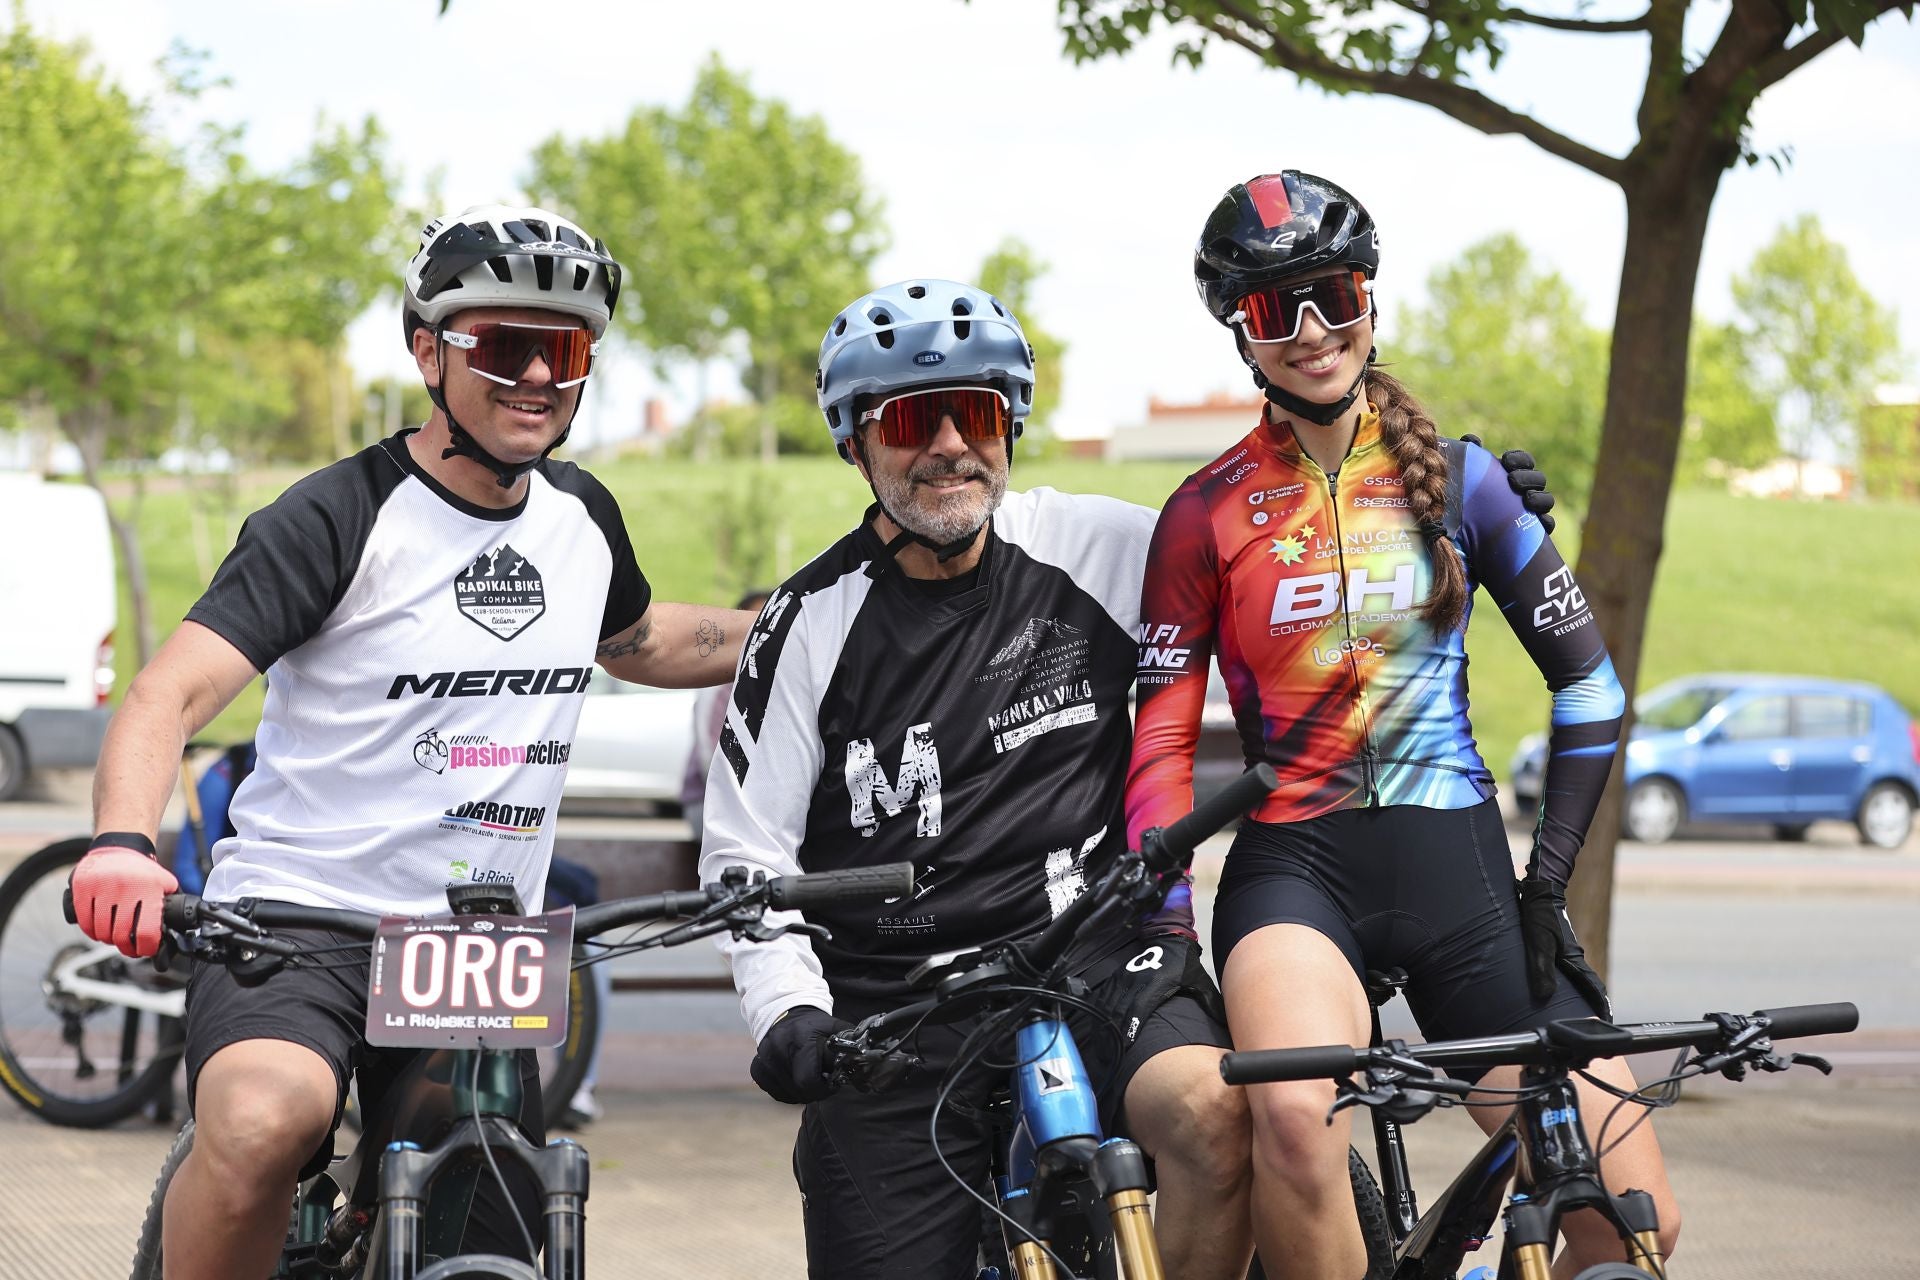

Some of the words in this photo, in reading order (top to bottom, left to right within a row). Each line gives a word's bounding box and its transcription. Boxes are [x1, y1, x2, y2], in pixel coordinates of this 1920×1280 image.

[917, 354, 942, 364] BELL
[1210, 448, 1248, 475] SHIMANO
[1272, 504, 1311, 518] REYNA
[1316, 536, 1335, 550] LA
[1350, 546, 1368, 554] DEL
[1369, 542, 1413, 553] DEPORTE
[457, 580, 513, 593] RADIKAL
[514, 580, 542, 592] BIKE
[1270, 565, 1415, 625] BH
[1270, 618, 1334, 637] COLOMA
[1338, 613, 1410, 626] ACADEMY
[974, 667, 1013, 684] FIREFOX
[1020, 673, 1068, 694] ELEVATION
[988, 680, 1092, 732] MONKALVILLO
[845, 722, 942, 838] M
[471, 868, 485, 882] La
[878, 914, 935, 925] ASSAULT
[402, 935, 545, 1008] ORG
[385, 1013, 405, 1027] La
[478, 1016, 512, 1028] RACE
